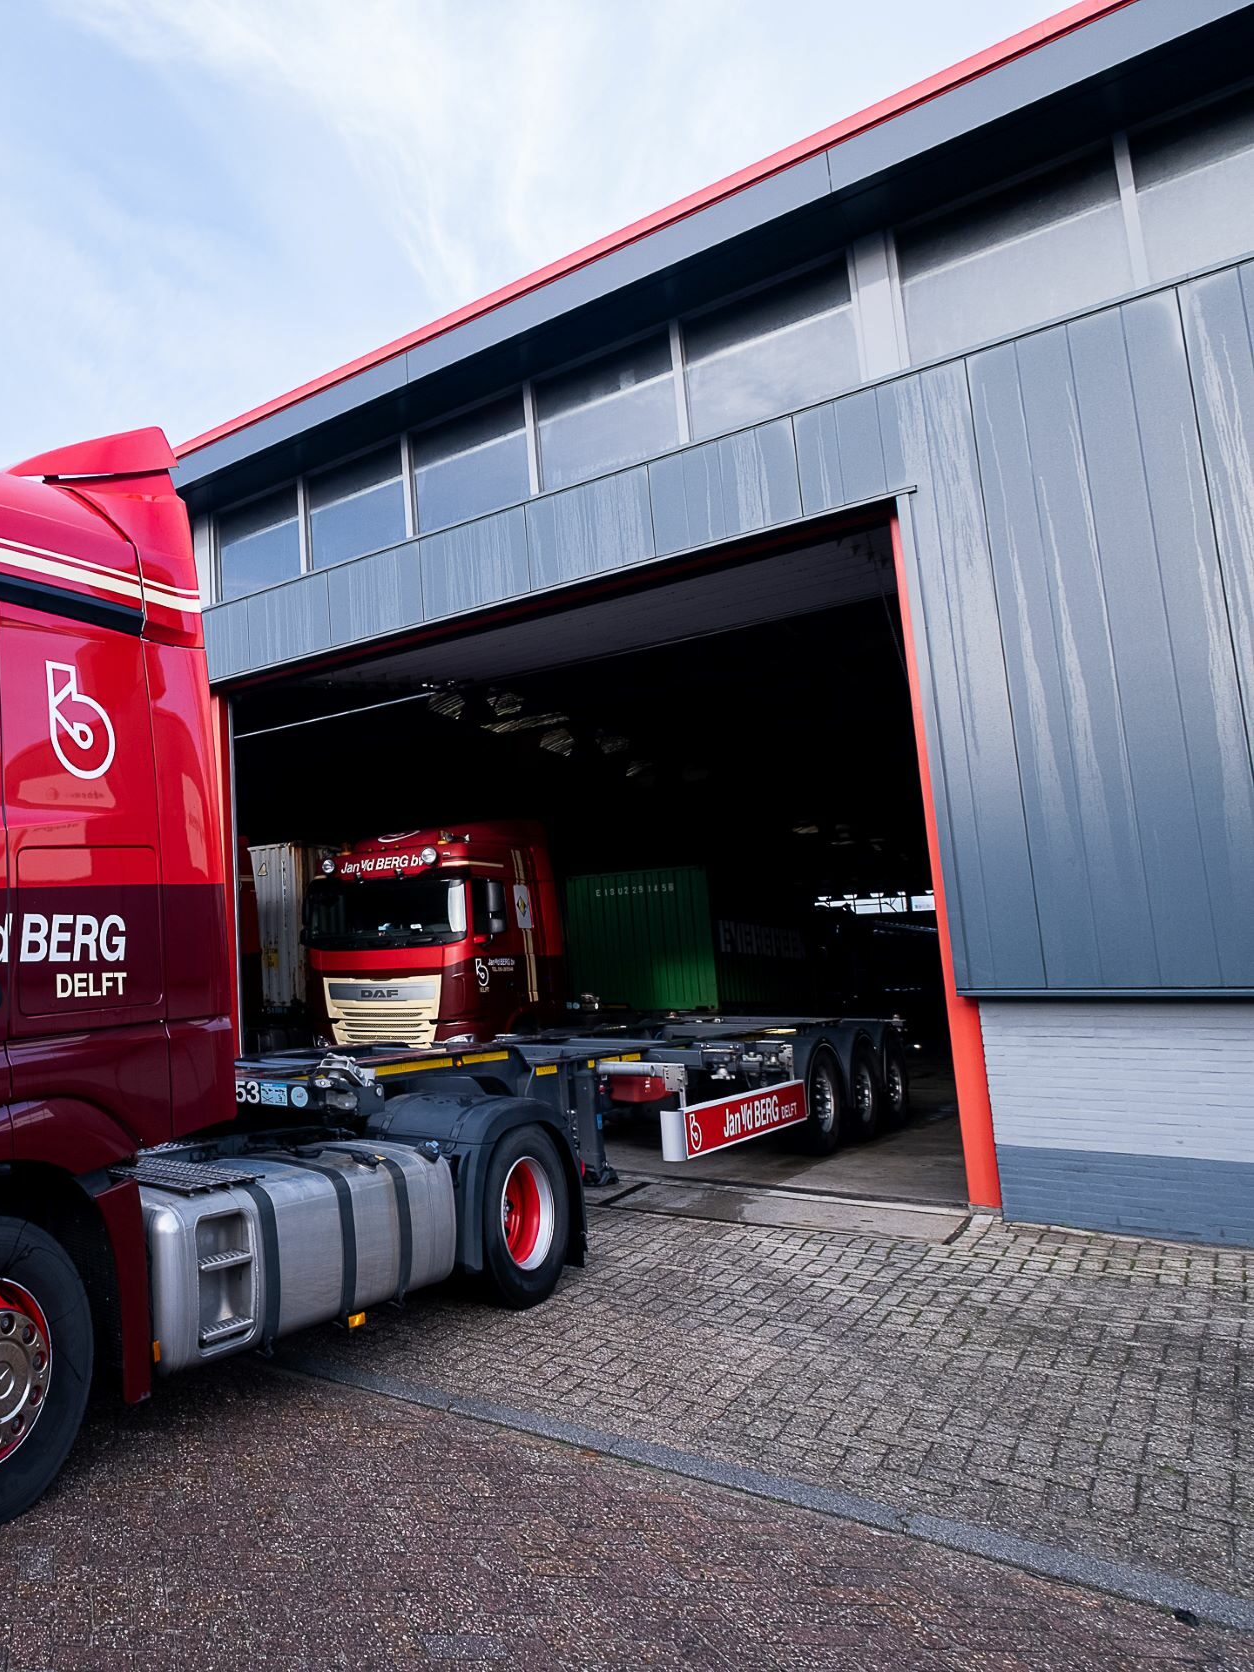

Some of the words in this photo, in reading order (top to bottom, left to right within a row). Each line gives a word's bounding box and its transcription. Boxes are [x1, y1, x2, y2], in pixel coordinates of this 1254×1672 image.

[340, 861, 360, 874] Jan
[375, 855, 408, 870] BERG
[19, 913, 127, 962] BERG
[56, 972, 127, 998] DELFT
[360, 989, 399, 998] DAF
[235, 1080, 260, 1104] 53
[723, 1108, 742, 1138] Jan
[754, 1095, 779, 1128] BERG
[781, 1102, 797, 1119] DELFT
